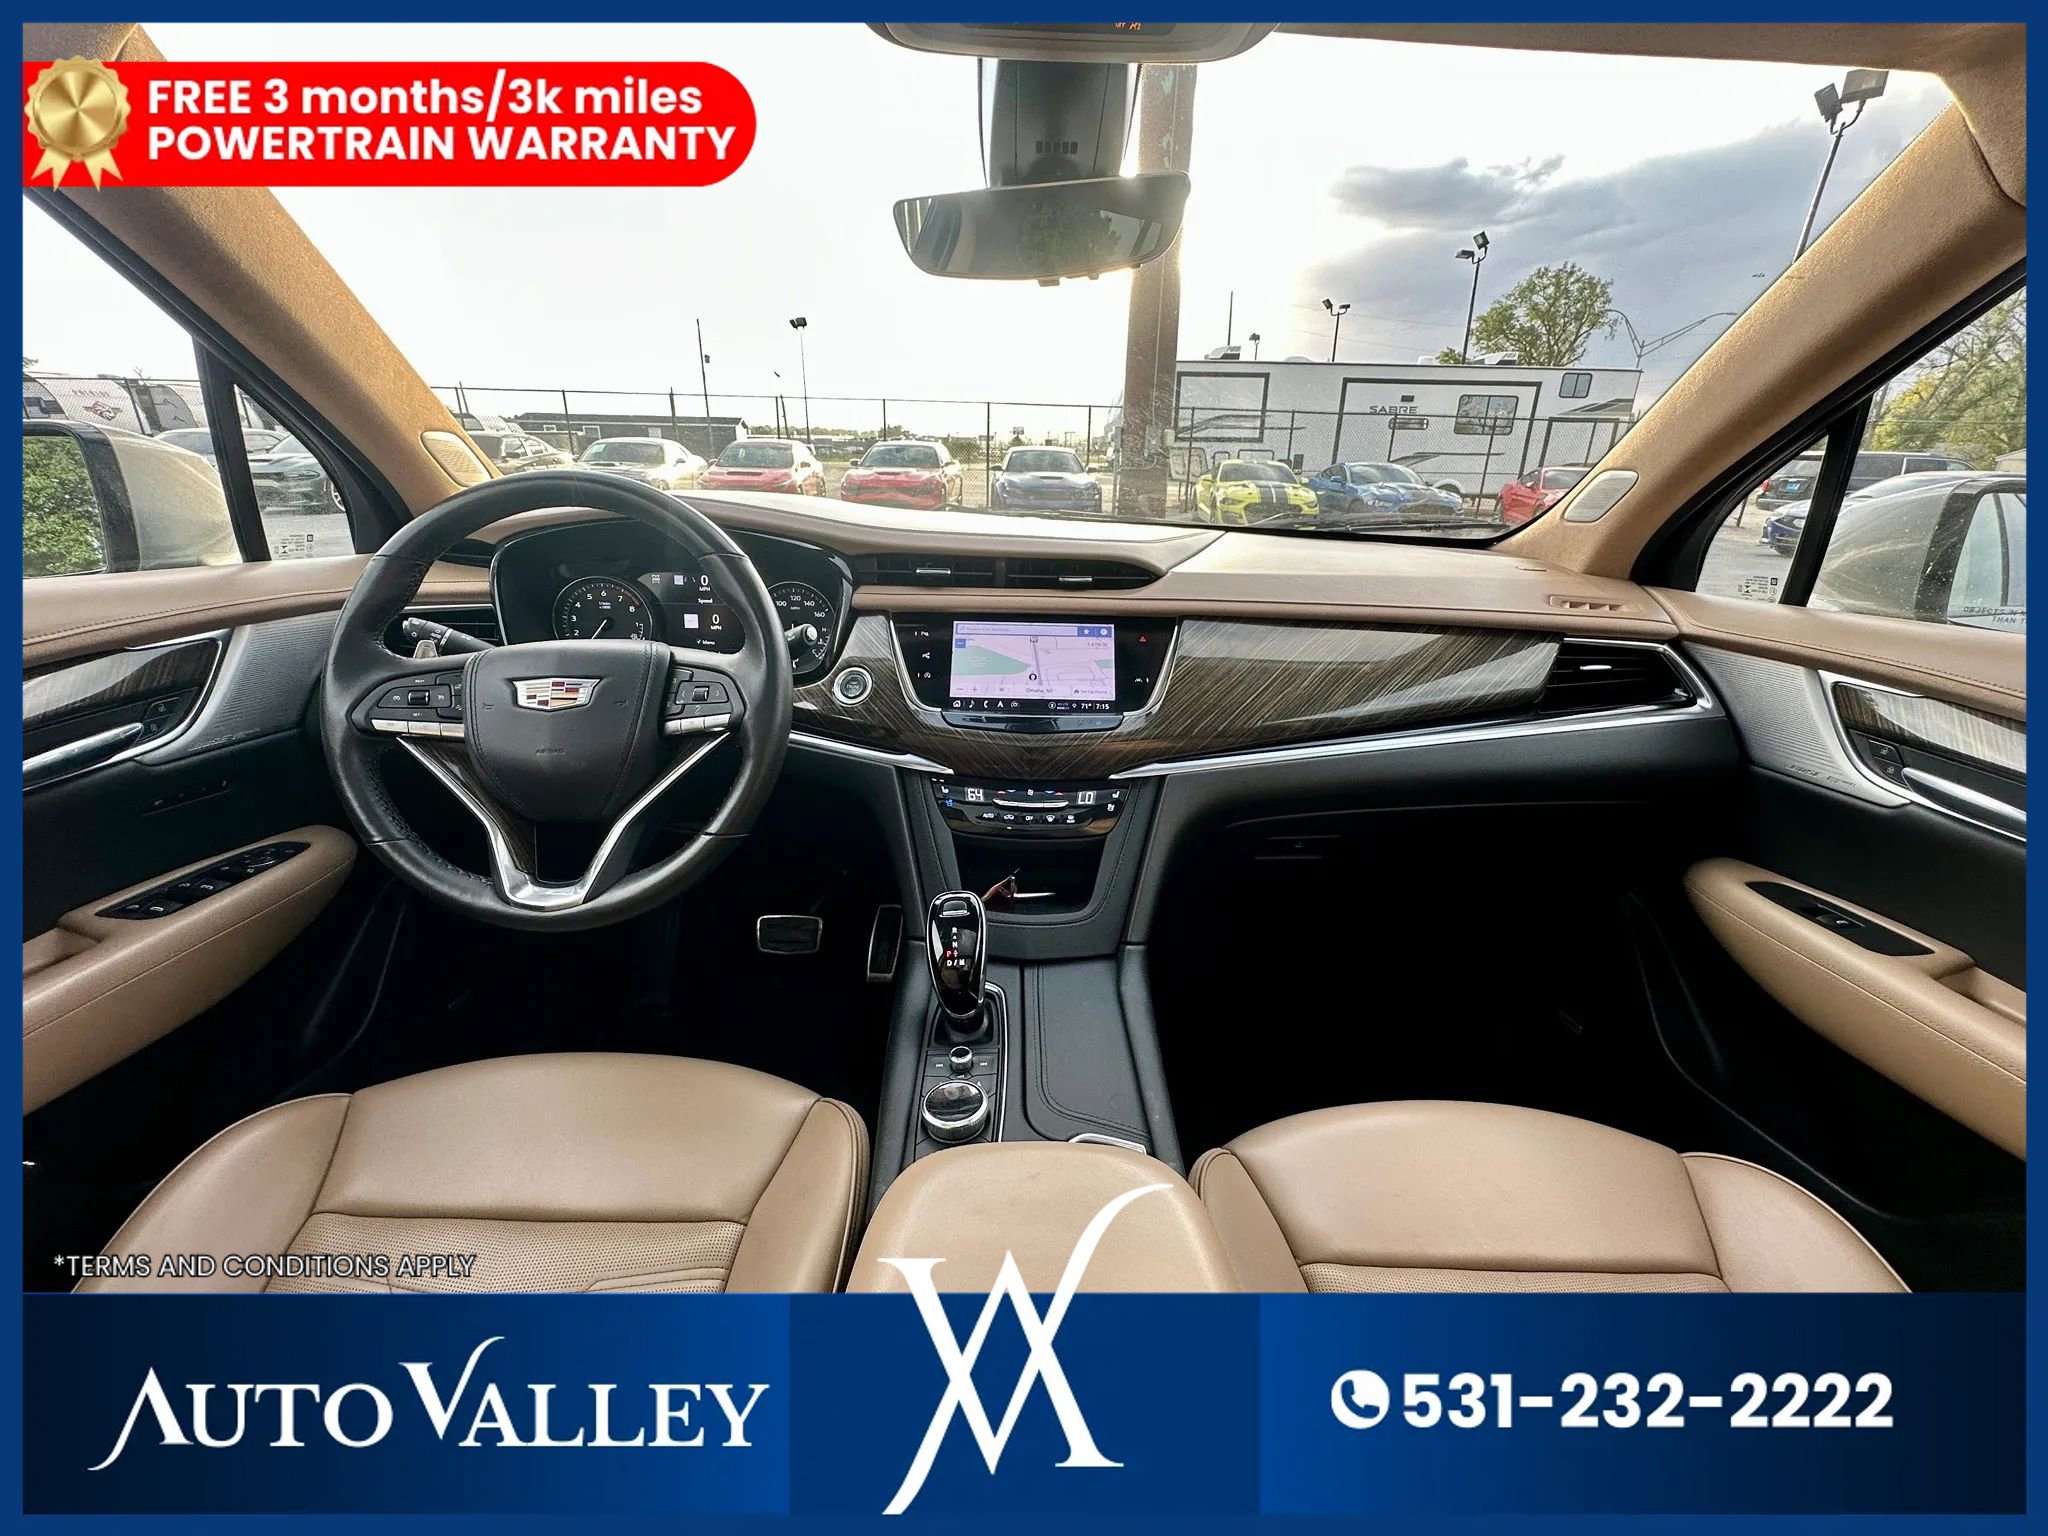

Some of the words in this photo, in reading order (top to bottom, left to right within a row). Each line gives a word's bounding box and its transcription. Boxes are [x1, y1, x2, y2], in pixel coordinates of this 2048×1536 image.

[1369, 405, 1418, 415] SABRE
[629, 605, 636, 613] 8
[1963, 606, 2006, 616] OBJECTS
[1992, 616, 2016, 624] THAN
[967, 788, 984, 800] 64
[952, 926, 958, 934] R
